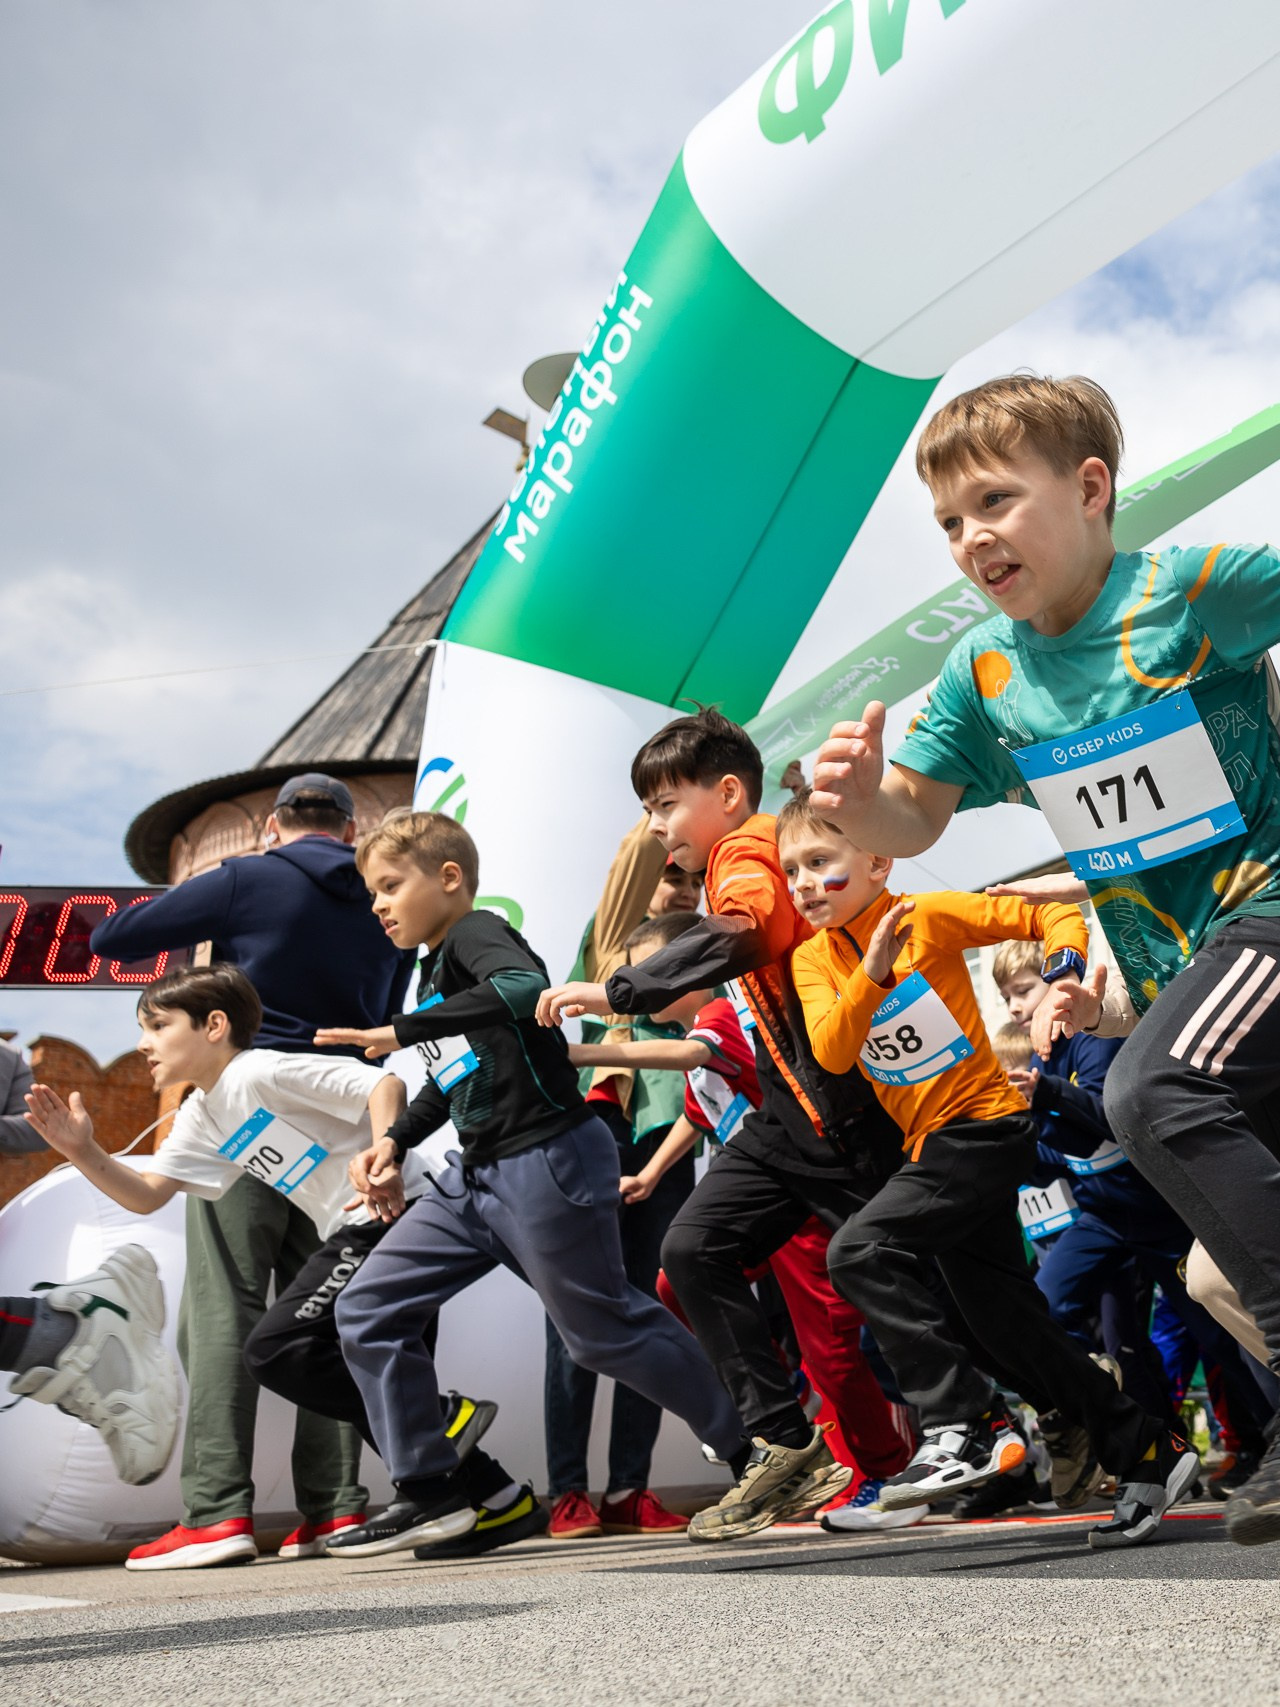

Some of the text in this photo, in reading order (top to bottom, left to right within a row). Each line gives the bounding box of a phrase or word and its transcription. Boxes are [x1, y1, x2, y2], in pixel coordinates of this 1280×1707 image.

[1068, 722, 1144, 760] СБЕР KIDS
[1075, 764, 1166, 830] 171
[1087, 850, 1116, 872] 420
[876, 997, 901, 1018] KIDS
[864, 1024, 923, 1062] 358
[1023, 1190, 1052, 1217] 111
